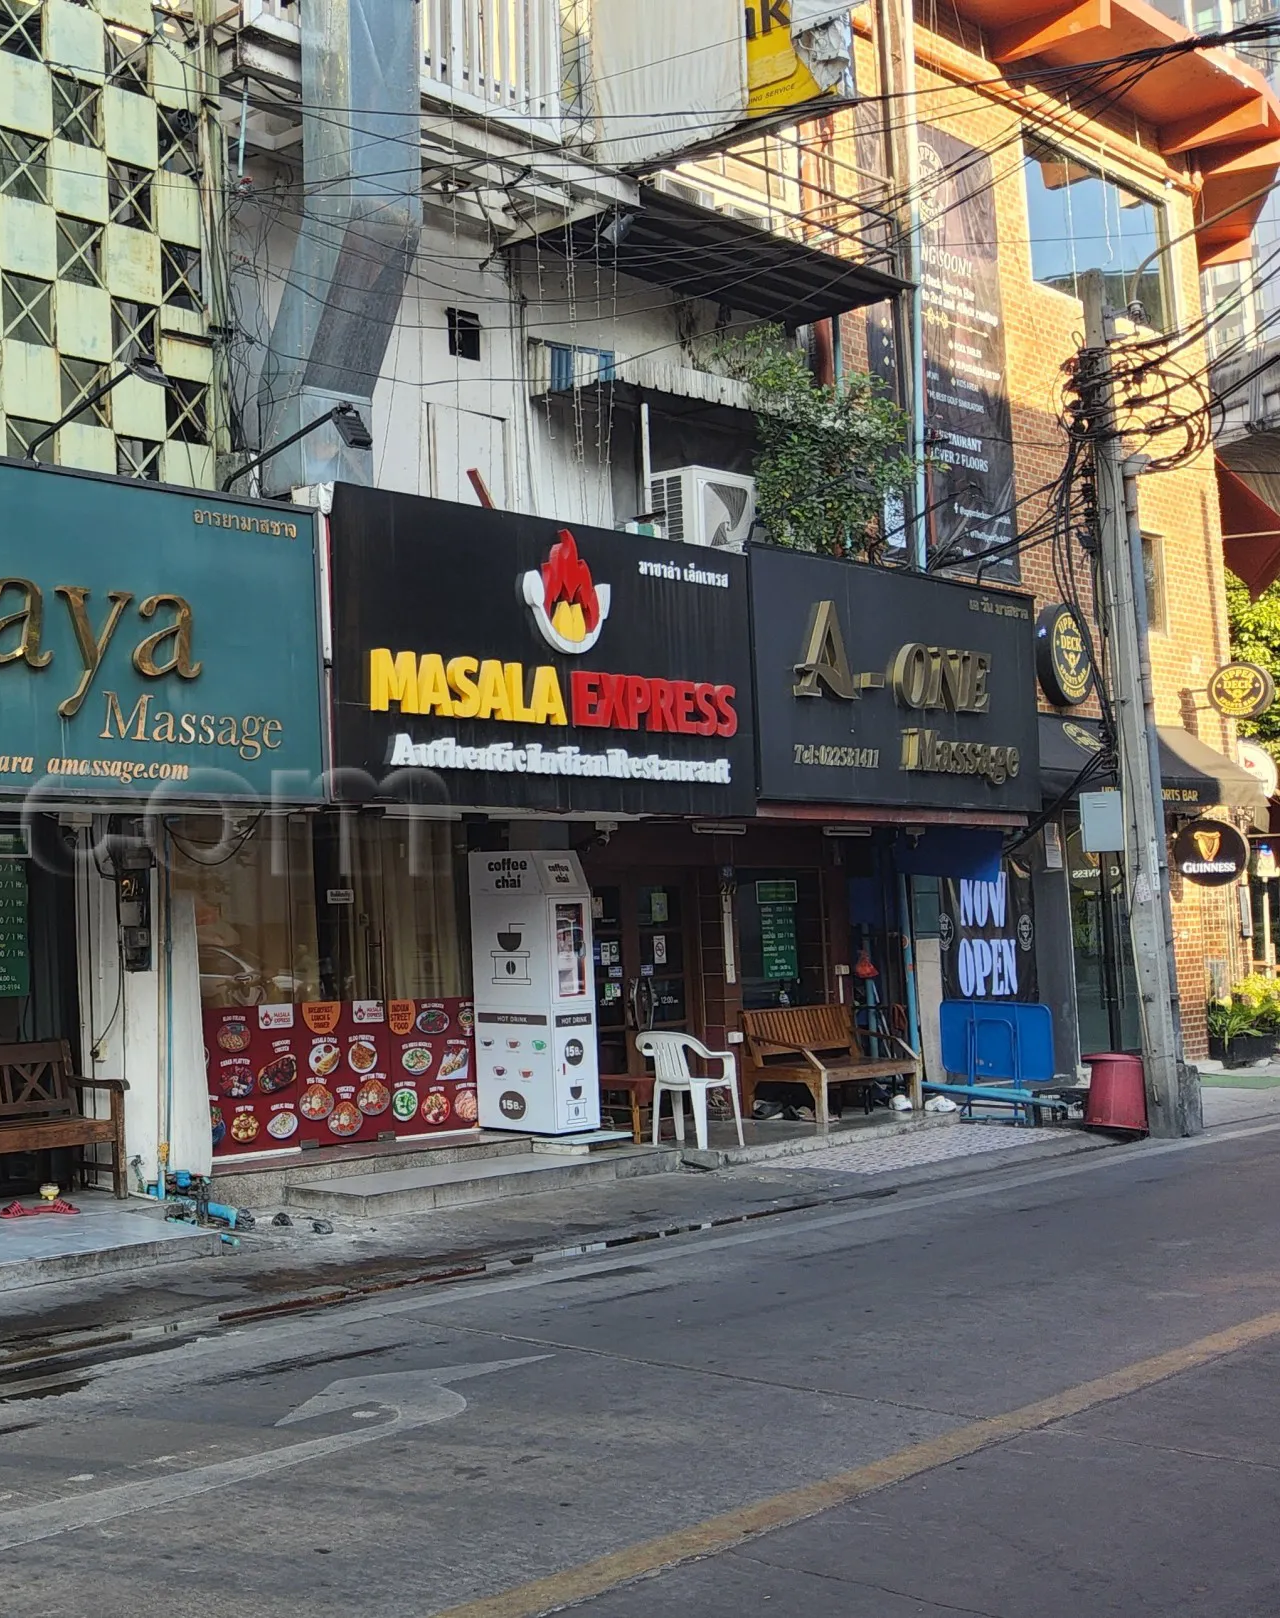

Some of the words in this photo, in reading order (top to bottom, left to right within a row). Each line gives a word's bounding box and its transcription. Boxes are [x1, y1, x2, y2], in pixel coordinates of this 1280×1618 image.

[961, 454, 989, 472] FLOORS
[1058, 616, 1081, 634] UPPE
[1060, 635, 1082, 652] DECK
[1221, 669, 1255, 682] UPPER
[1223, 680, 1253, 689] DECK
[369, 648, 567, 726] MASALA
[571, 670, 739, 738] EXPRESS
[98, 691, 283, 760] Massage
[390, 734, 527, 772] Authentic
[607, 748, 732, 784] Restaurant
[899, 727, 1020, 785] Massage
[1182, 790, 1198, 802] BAR
[488, 858, 527, 872] coffee
[548, 863, 569, 872] coffee
[1182, 861, 1237, 874] GUINNESS
[495, 874, 521, 889] chai
[960, 871, 1007, 928] NOW
[958, 937, 1018, 997] OPEN
[390, 1012, 411, 1021] STREET
[393, 1022, 409, 1030] FOOD
